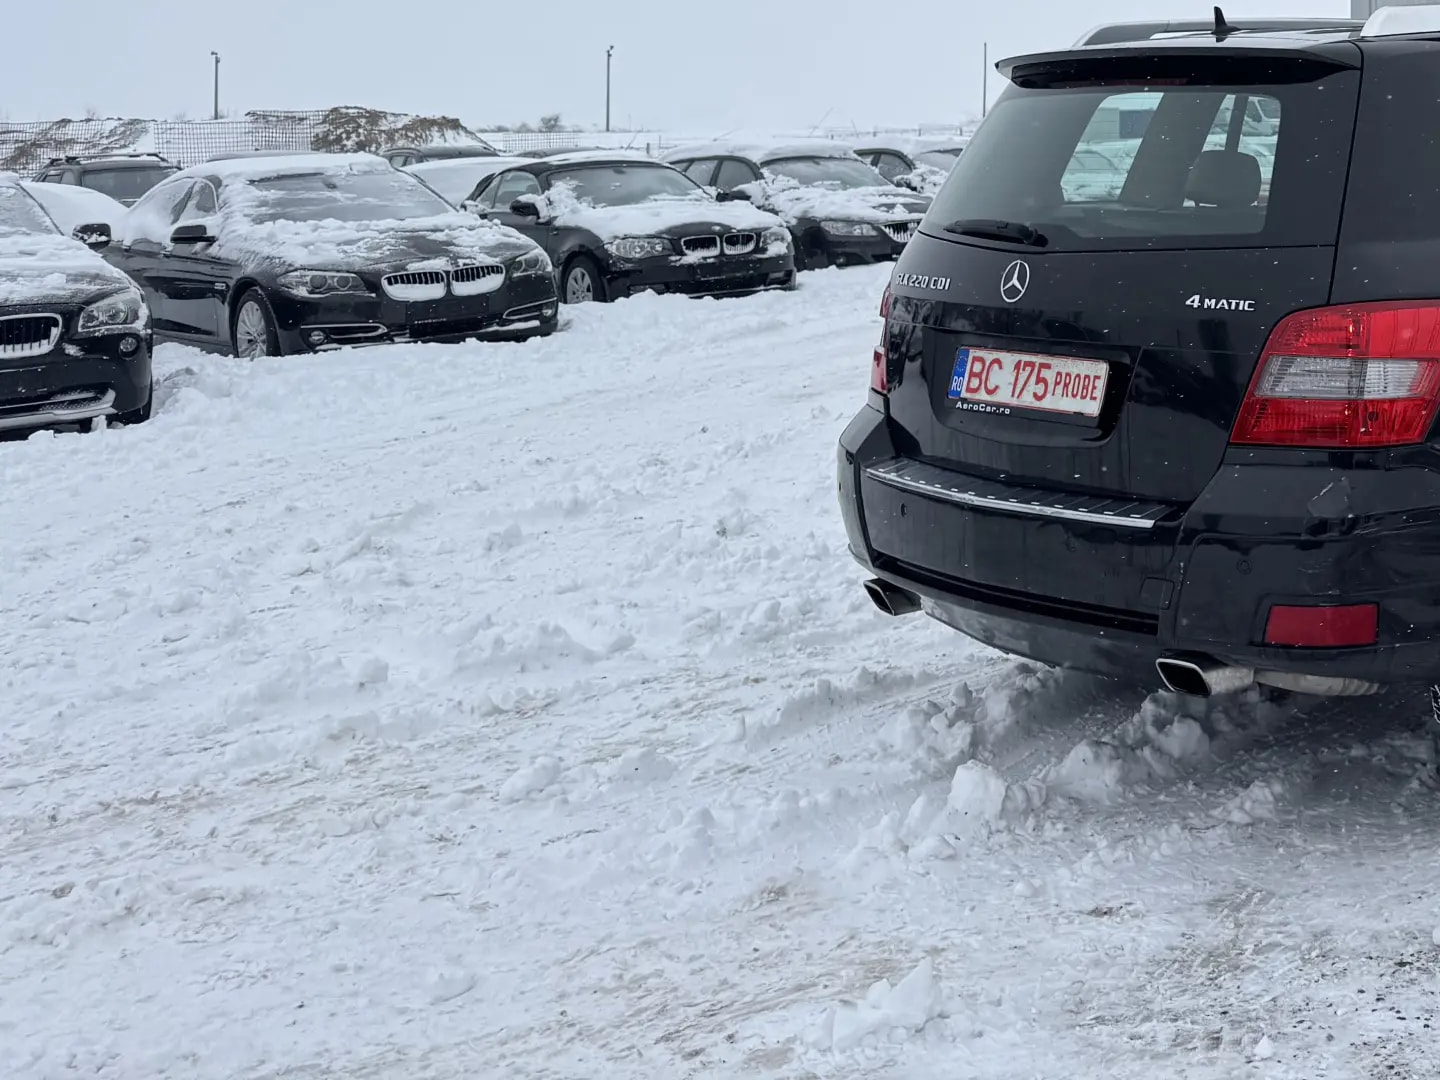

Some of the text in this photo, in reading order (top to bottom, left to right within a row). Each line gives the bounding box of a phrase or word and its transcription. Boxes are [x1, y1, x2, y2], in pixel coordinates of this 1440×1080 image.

[930, 276, 951, 291] CDI
[951, 376, 964, 392] RO
[965, 355, 1101, 402] BC 175 PROBE
[955, 401, 1011, 416] AeroCar.ro
